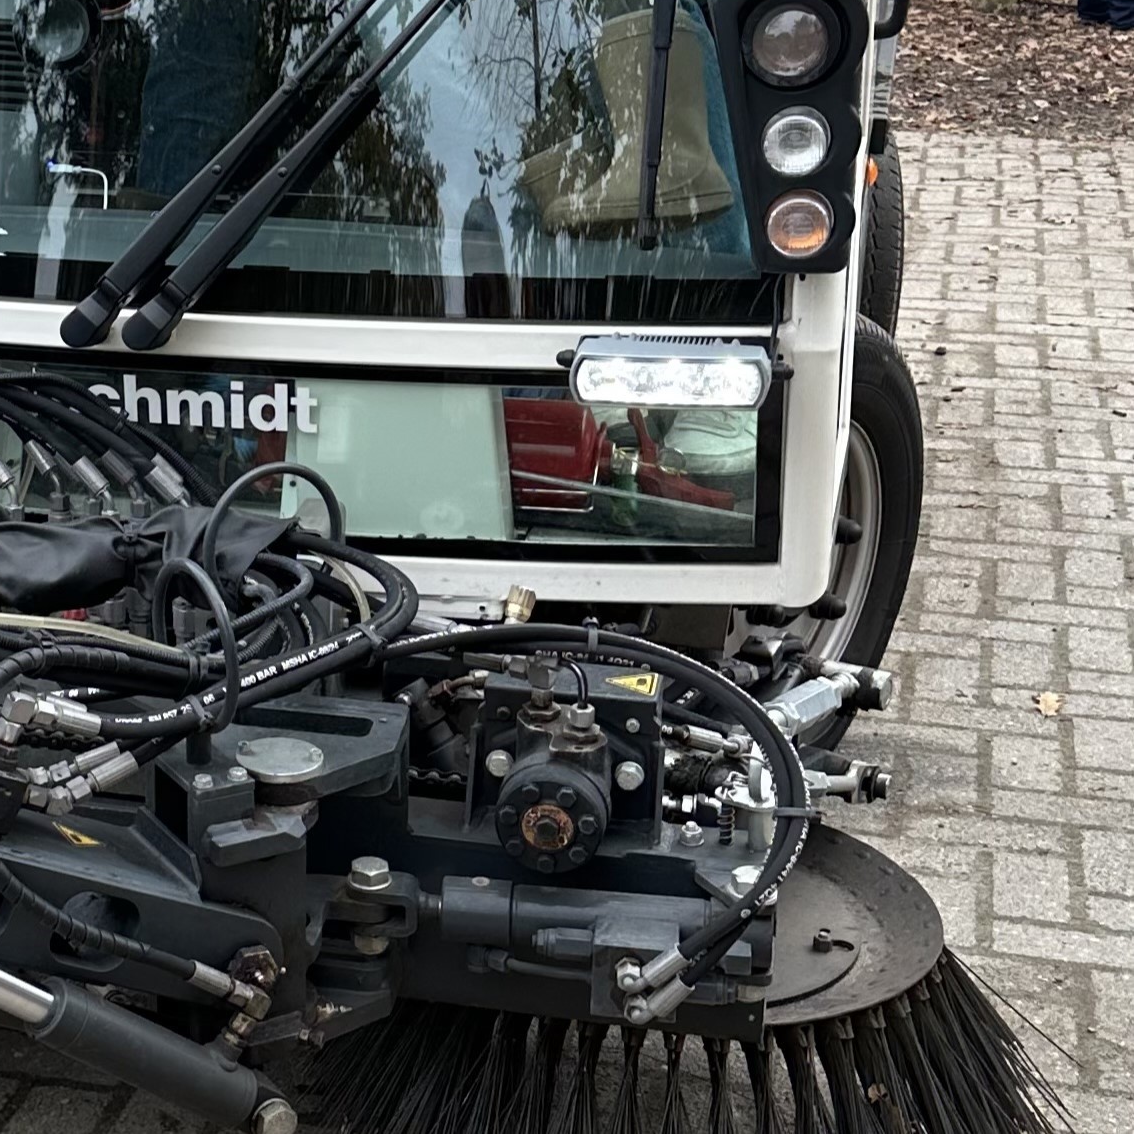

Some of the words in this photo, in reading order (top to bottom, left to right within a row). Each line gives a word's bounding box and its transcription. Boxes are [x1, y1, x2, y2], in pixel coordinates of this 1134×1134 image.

[88, 374, 318, 433] chmidt
[256, 665, 277, 680] BAR
[281, 653, 309, 670] MSHA
